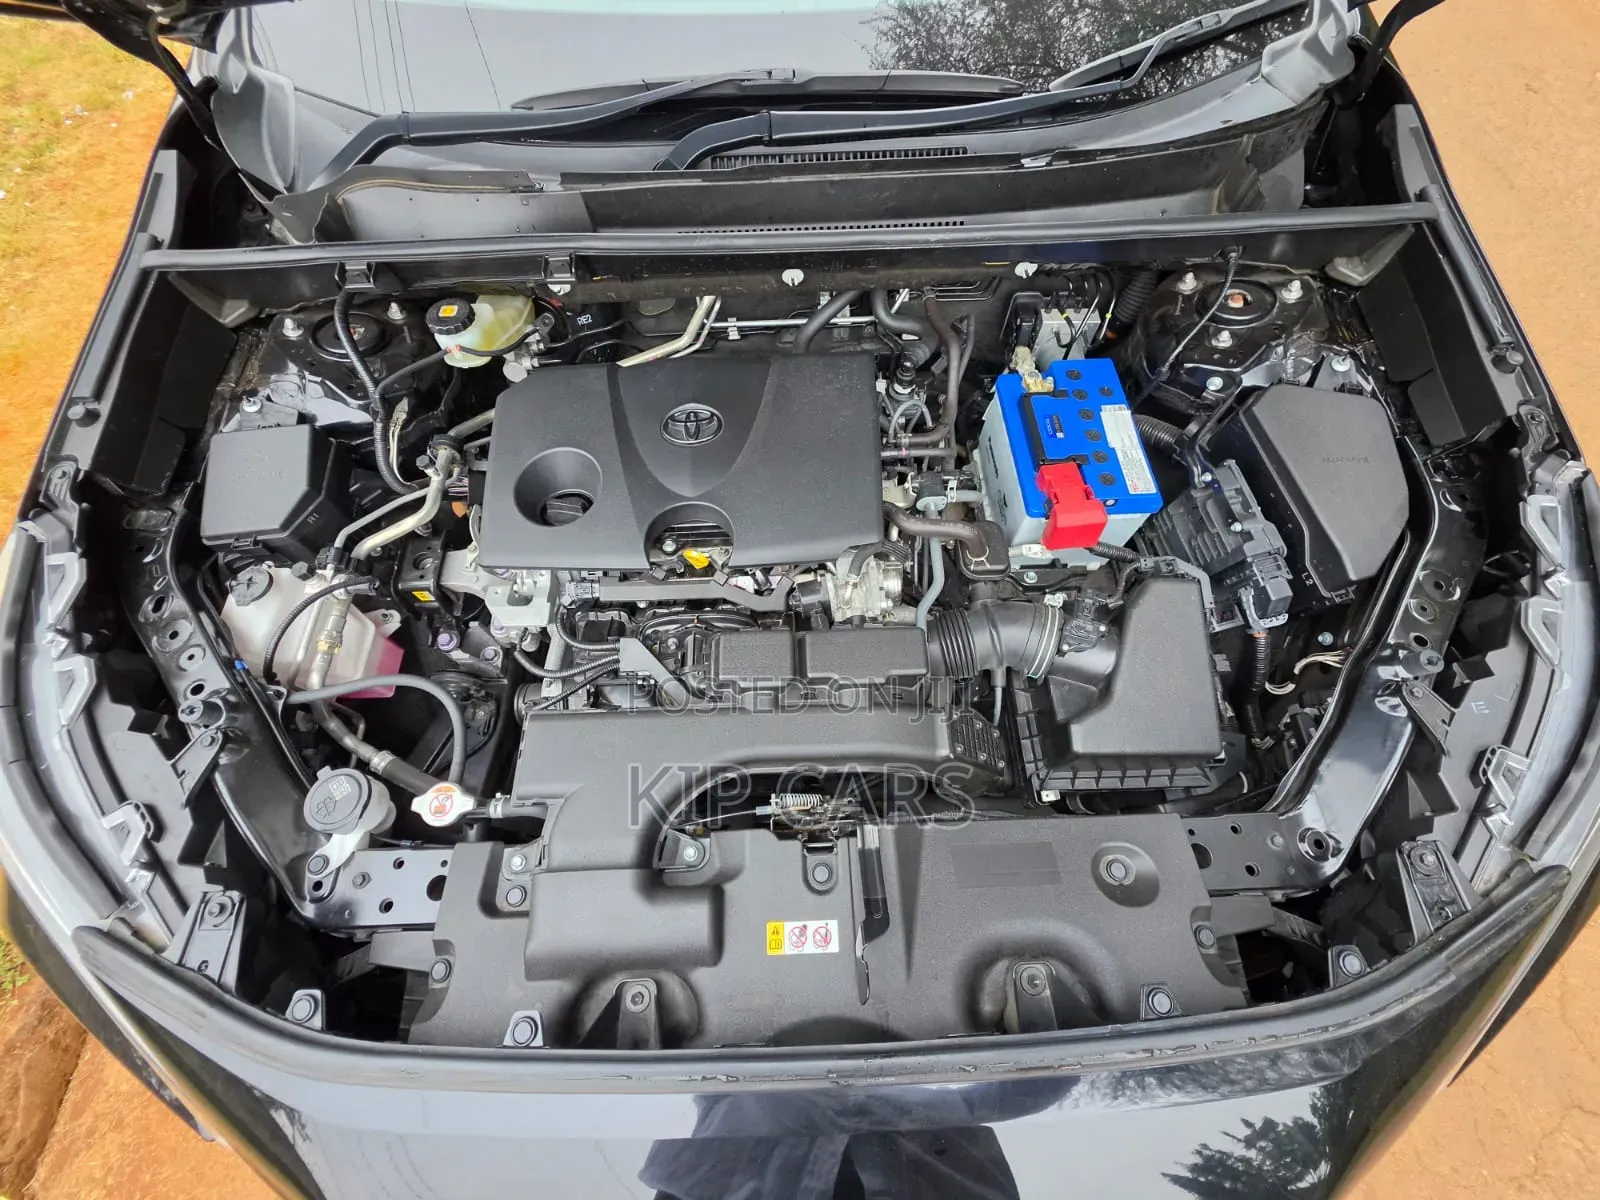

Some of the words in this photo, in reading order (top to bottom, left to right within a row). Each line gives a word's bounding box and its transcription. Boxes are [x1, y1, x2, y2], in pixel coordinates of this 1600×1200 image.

[576, 314, 593, 326] RE2
[306, 512, 320, 524] R1
[1301, 572, 1314, 586] L2
